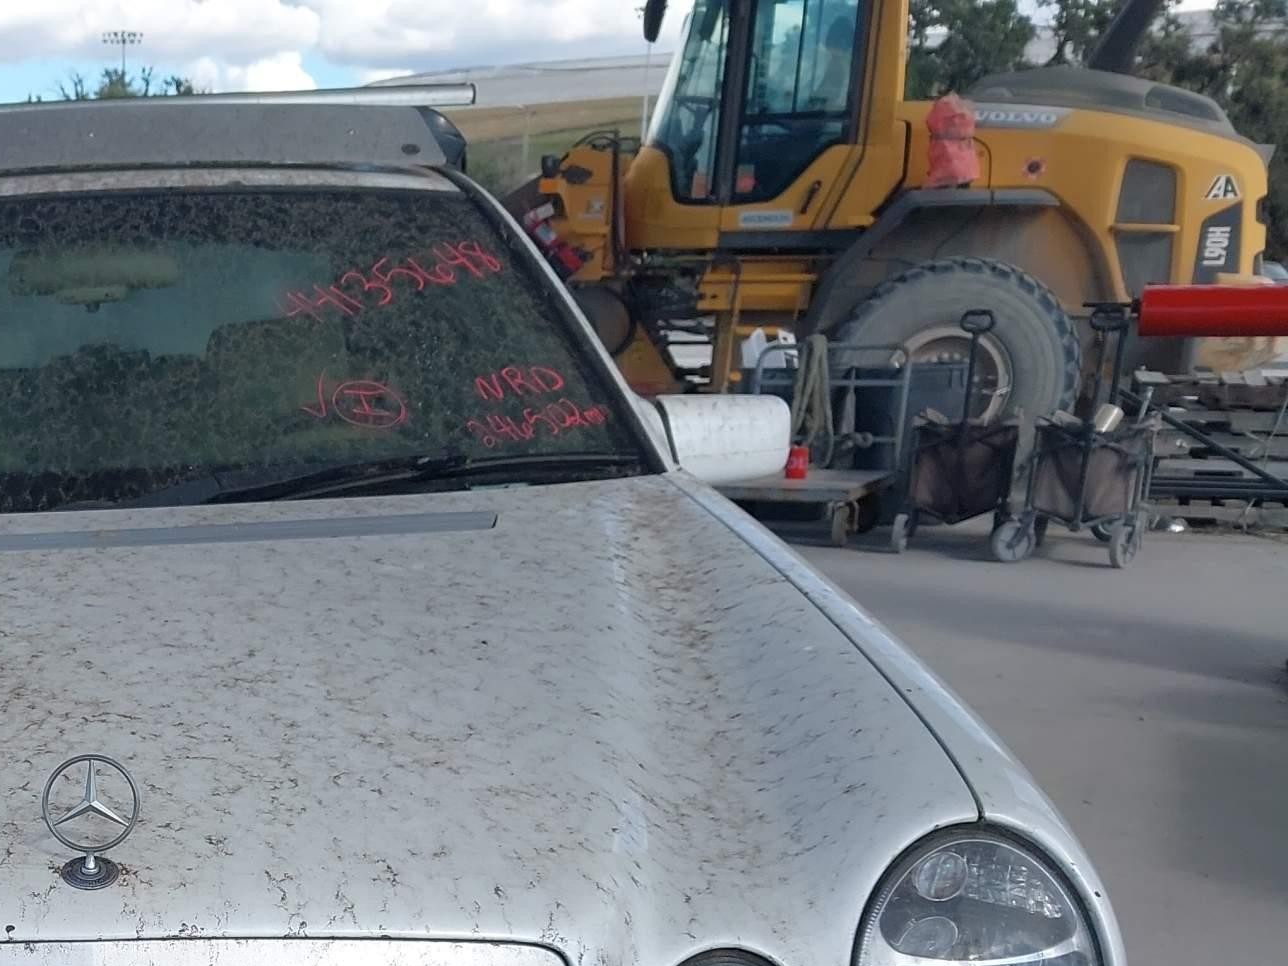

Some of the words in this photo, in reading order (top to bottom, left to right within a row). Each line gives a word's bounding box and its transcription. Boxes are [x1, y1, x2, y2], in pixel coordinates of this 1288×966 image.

[973, 110, 1057, 123] VOLVO
[1202, 225, 1232, 267] L90H
[282, 240, 502, 323] 44135648
[474, 366, 564, 401] NRD
